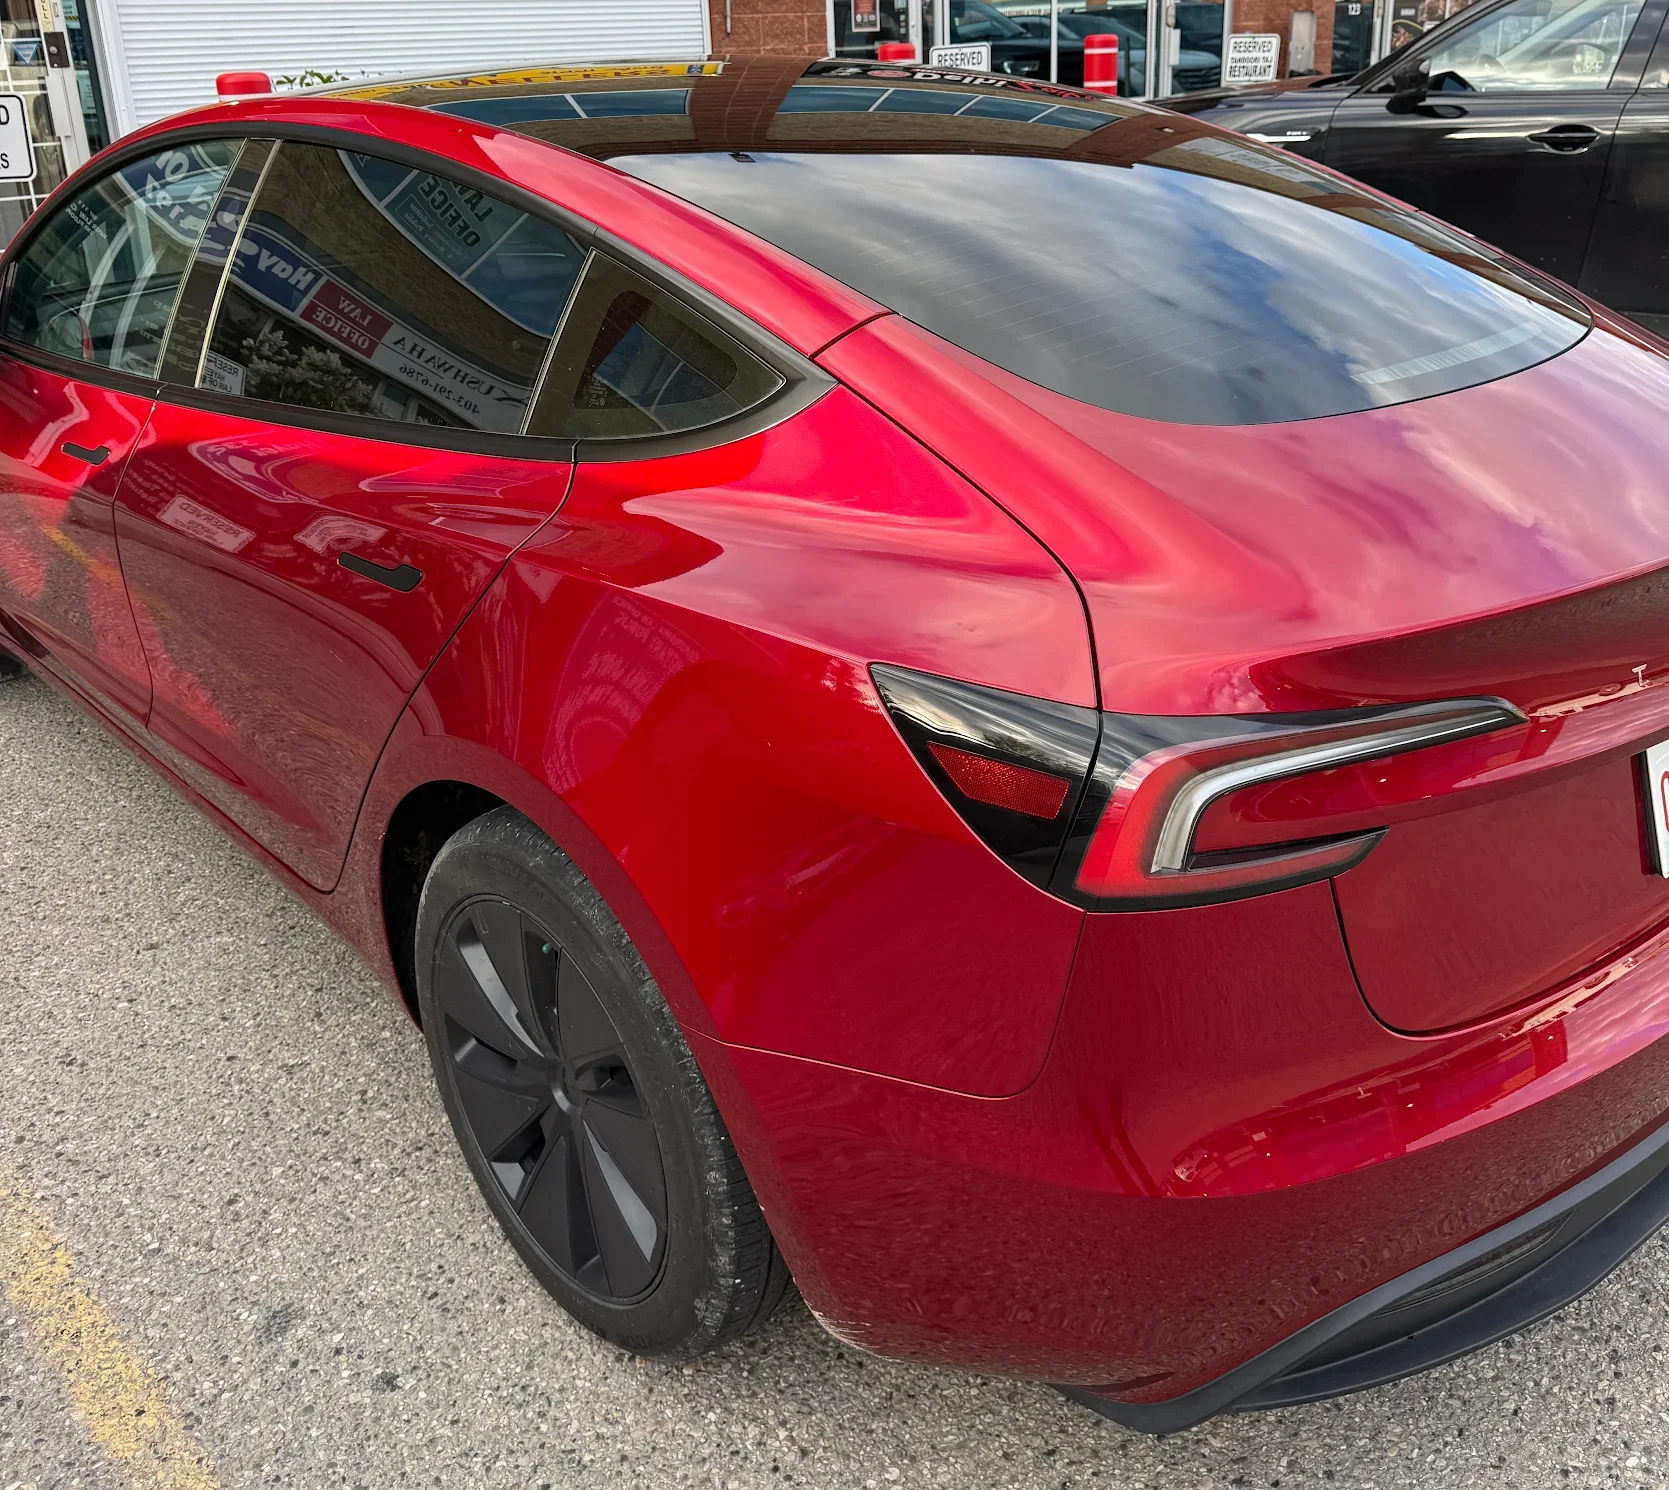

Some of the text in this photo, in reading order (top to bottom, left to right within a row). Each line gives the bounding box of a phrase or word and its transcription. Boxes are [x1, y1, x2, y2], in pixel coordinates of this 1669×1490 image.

[1348, 4, 1361, 15] 123
[1232, 41, 1272, 53] RESERVED
[938, 51, 983, 67] RESERVED
[1228, 65, 1272, 78] RESTAURANT
